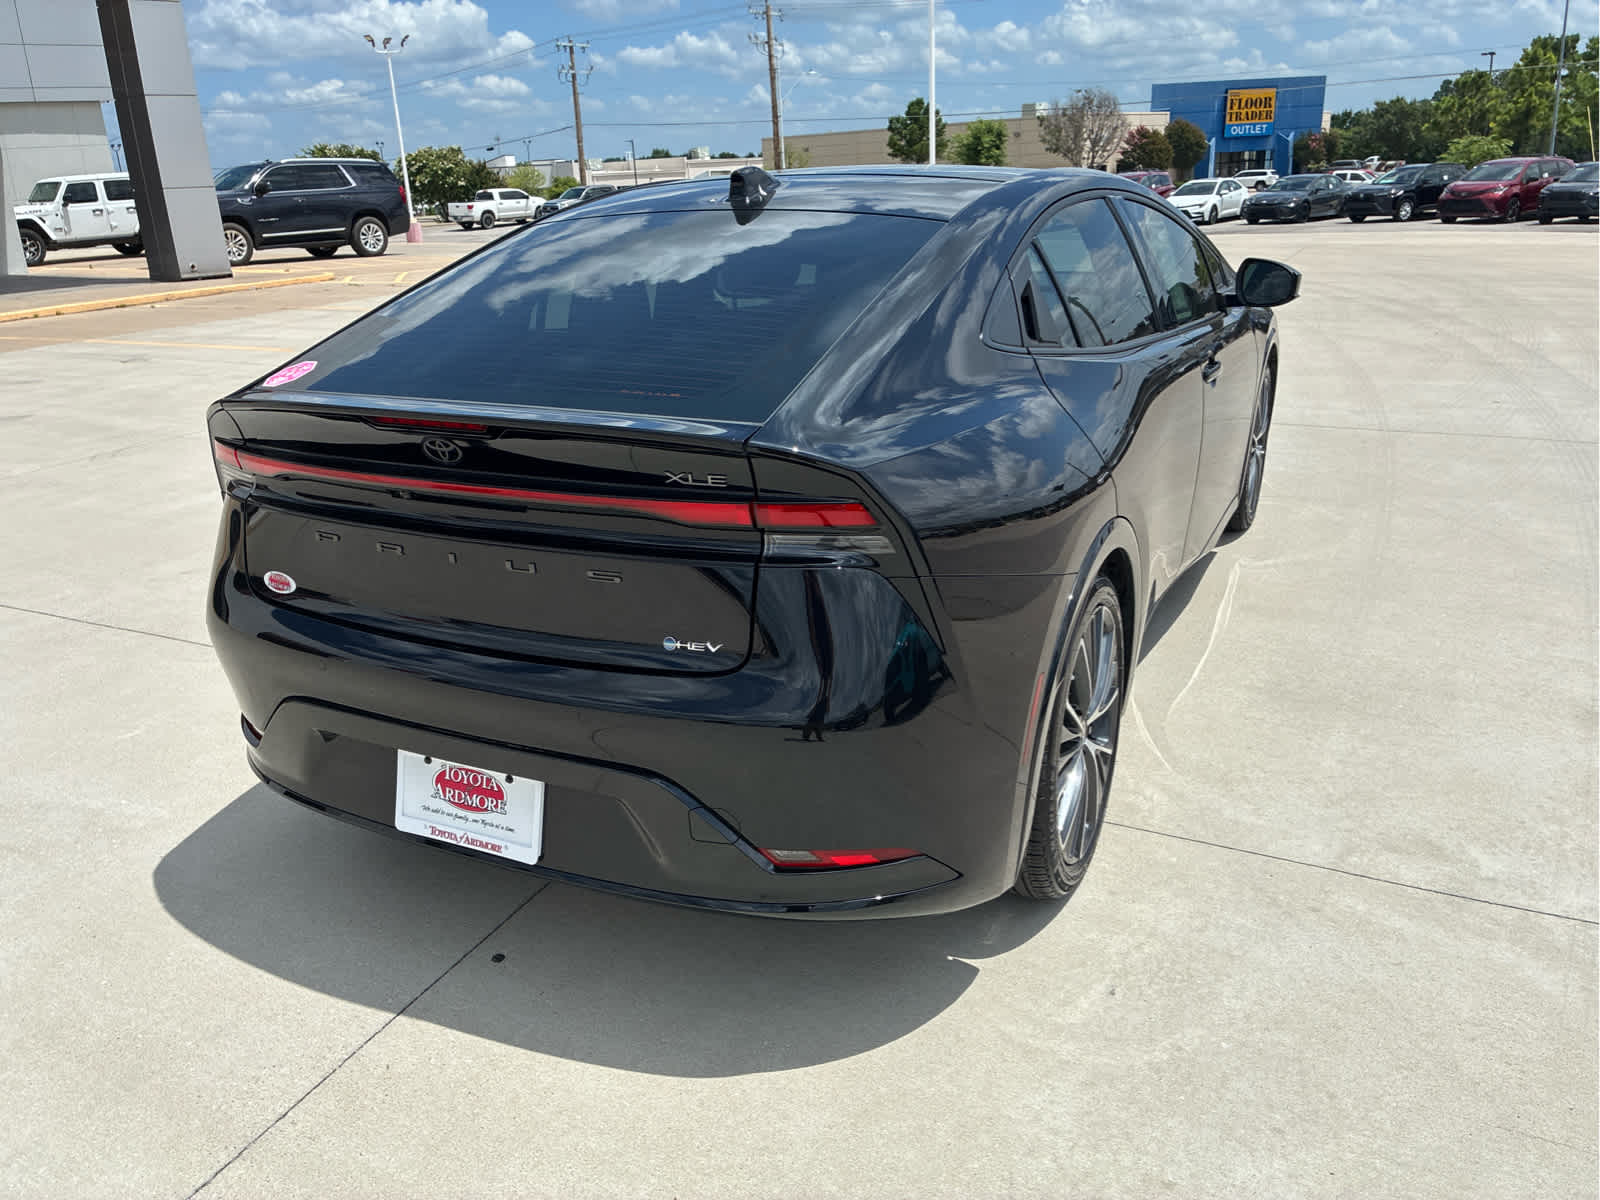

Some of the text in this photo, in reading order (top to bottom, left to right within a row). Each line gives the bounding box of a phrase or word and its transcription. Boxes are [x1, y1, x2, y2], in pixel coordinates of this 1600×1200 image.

[1229, 96, 1272, 110] FLOOR
[1227, 110, 1272, 122] TRADER
[1231, 124, 1267, 135] OUTLET
[664, 471, 728, 487] XLE
[316, 530, 623, 583] PRIUS
[676, 640, 723, 652] HEV
[441, 764, 498, 791] TOYOTA
[432, 782, 507, 815] ARDMORE
[429, 825, 459, 842] TOYOTA
[464, 832, 503, 853] ARDMORE
